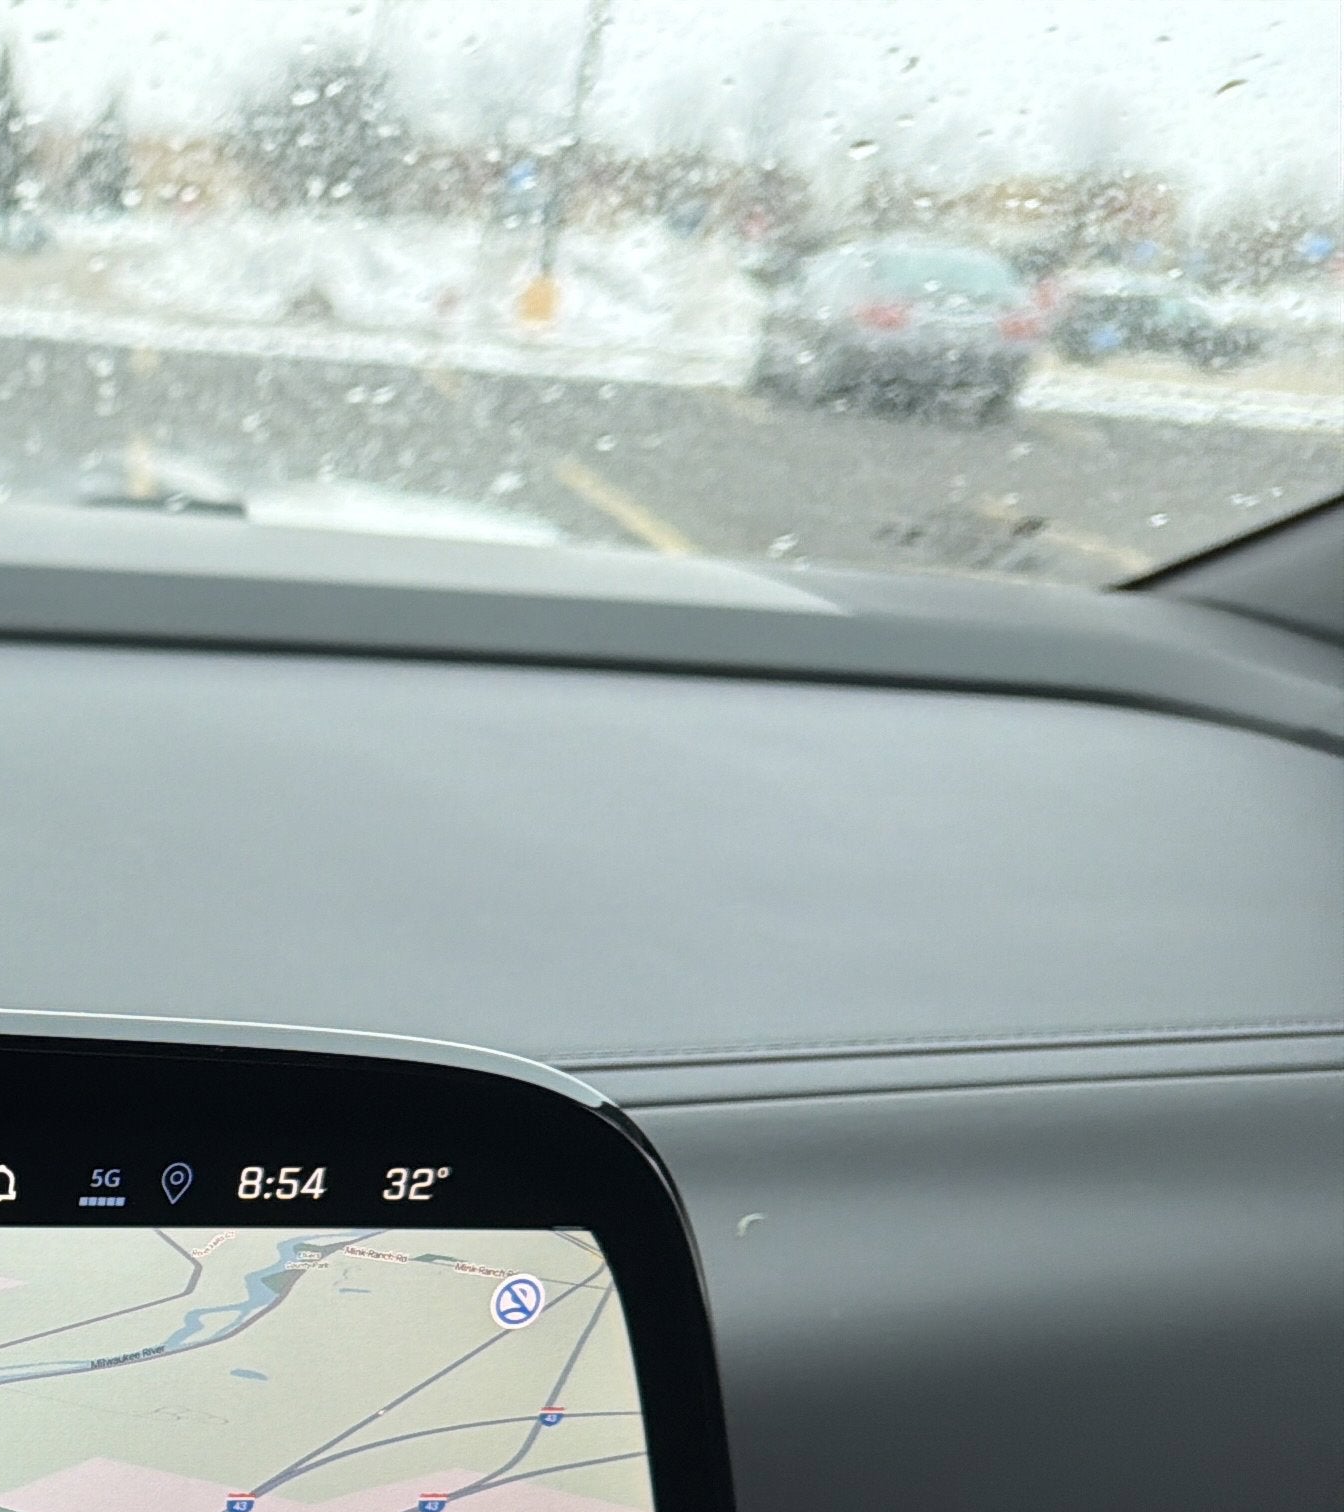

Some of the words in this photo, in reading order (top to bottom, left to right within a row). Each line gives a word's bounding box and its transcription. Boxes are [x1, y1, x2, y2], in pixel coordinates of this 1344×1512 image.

[91, 1168, 120, 1188] 5G
[238, 1167, 327, 1200] 8:54
[382, 1166, 451, 1201] 32°
[233, 1501, 248, 1511] 43
[425, 1501, 439, 1511] 43
